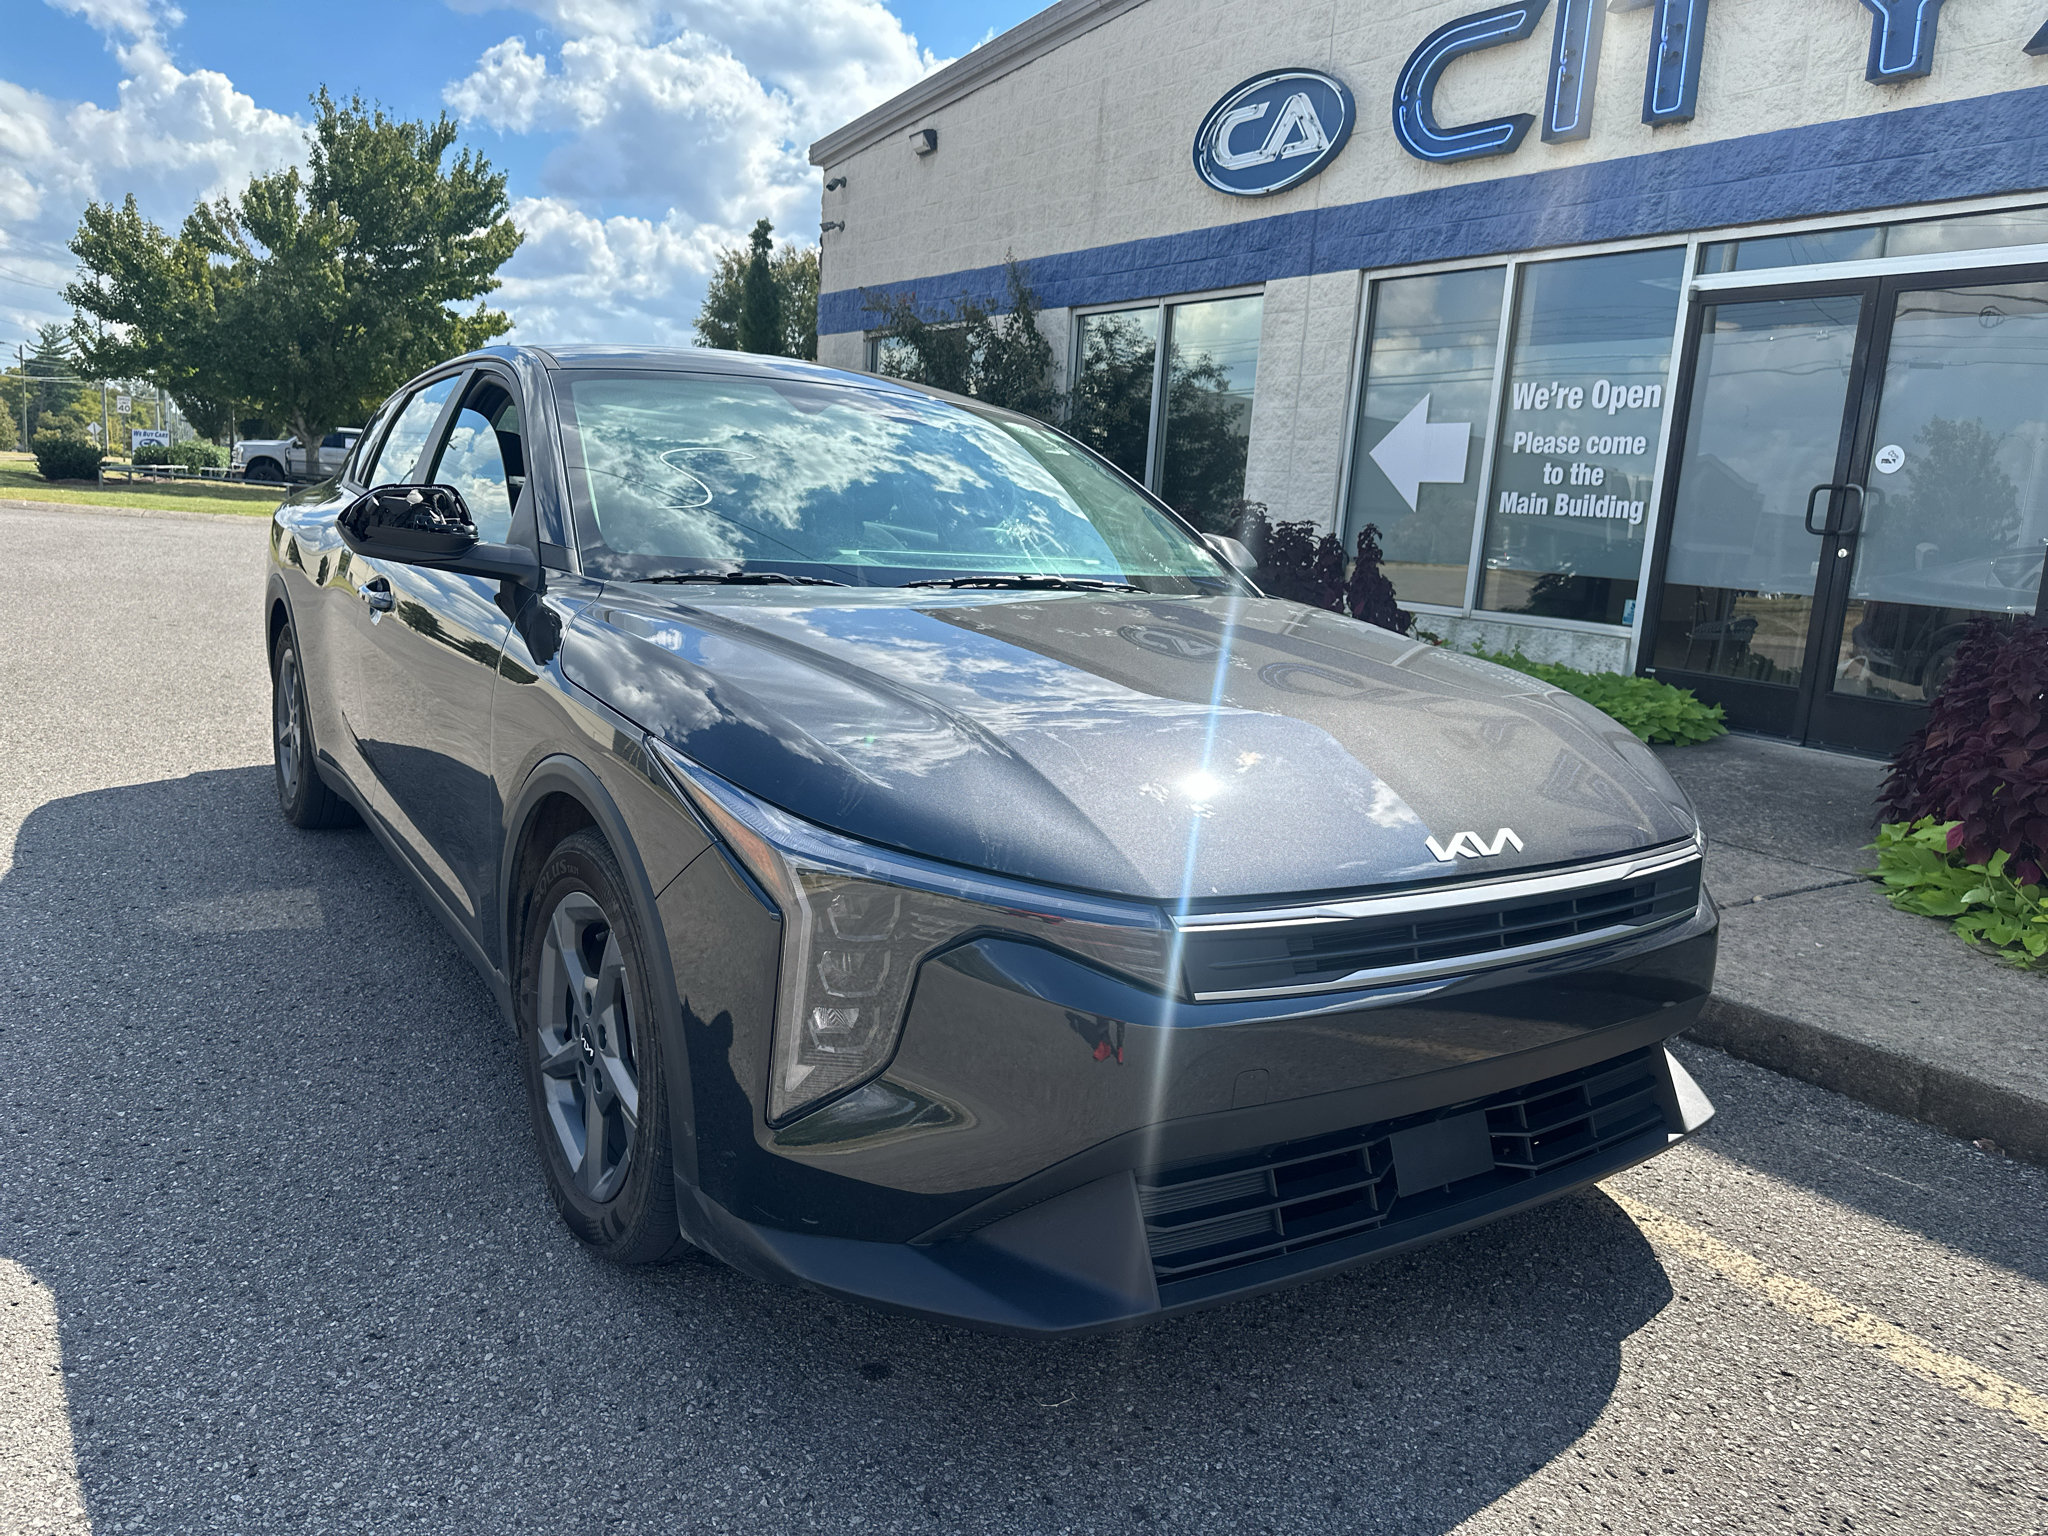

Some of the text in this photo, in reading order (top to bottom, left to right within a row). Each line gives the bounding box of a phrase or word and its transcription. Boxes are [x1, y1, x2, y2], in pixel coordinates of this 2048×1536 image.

[1211, 92, 1331, 170] CA
[1513, 379, 1662, 415] We're Open
[1513, 431, 1646, 455] Please come
[1543, 462, 1604, 486] to the
[1499, 491, 1645, 525] Main Building
[1424, 828, 1524, 863] KIA
